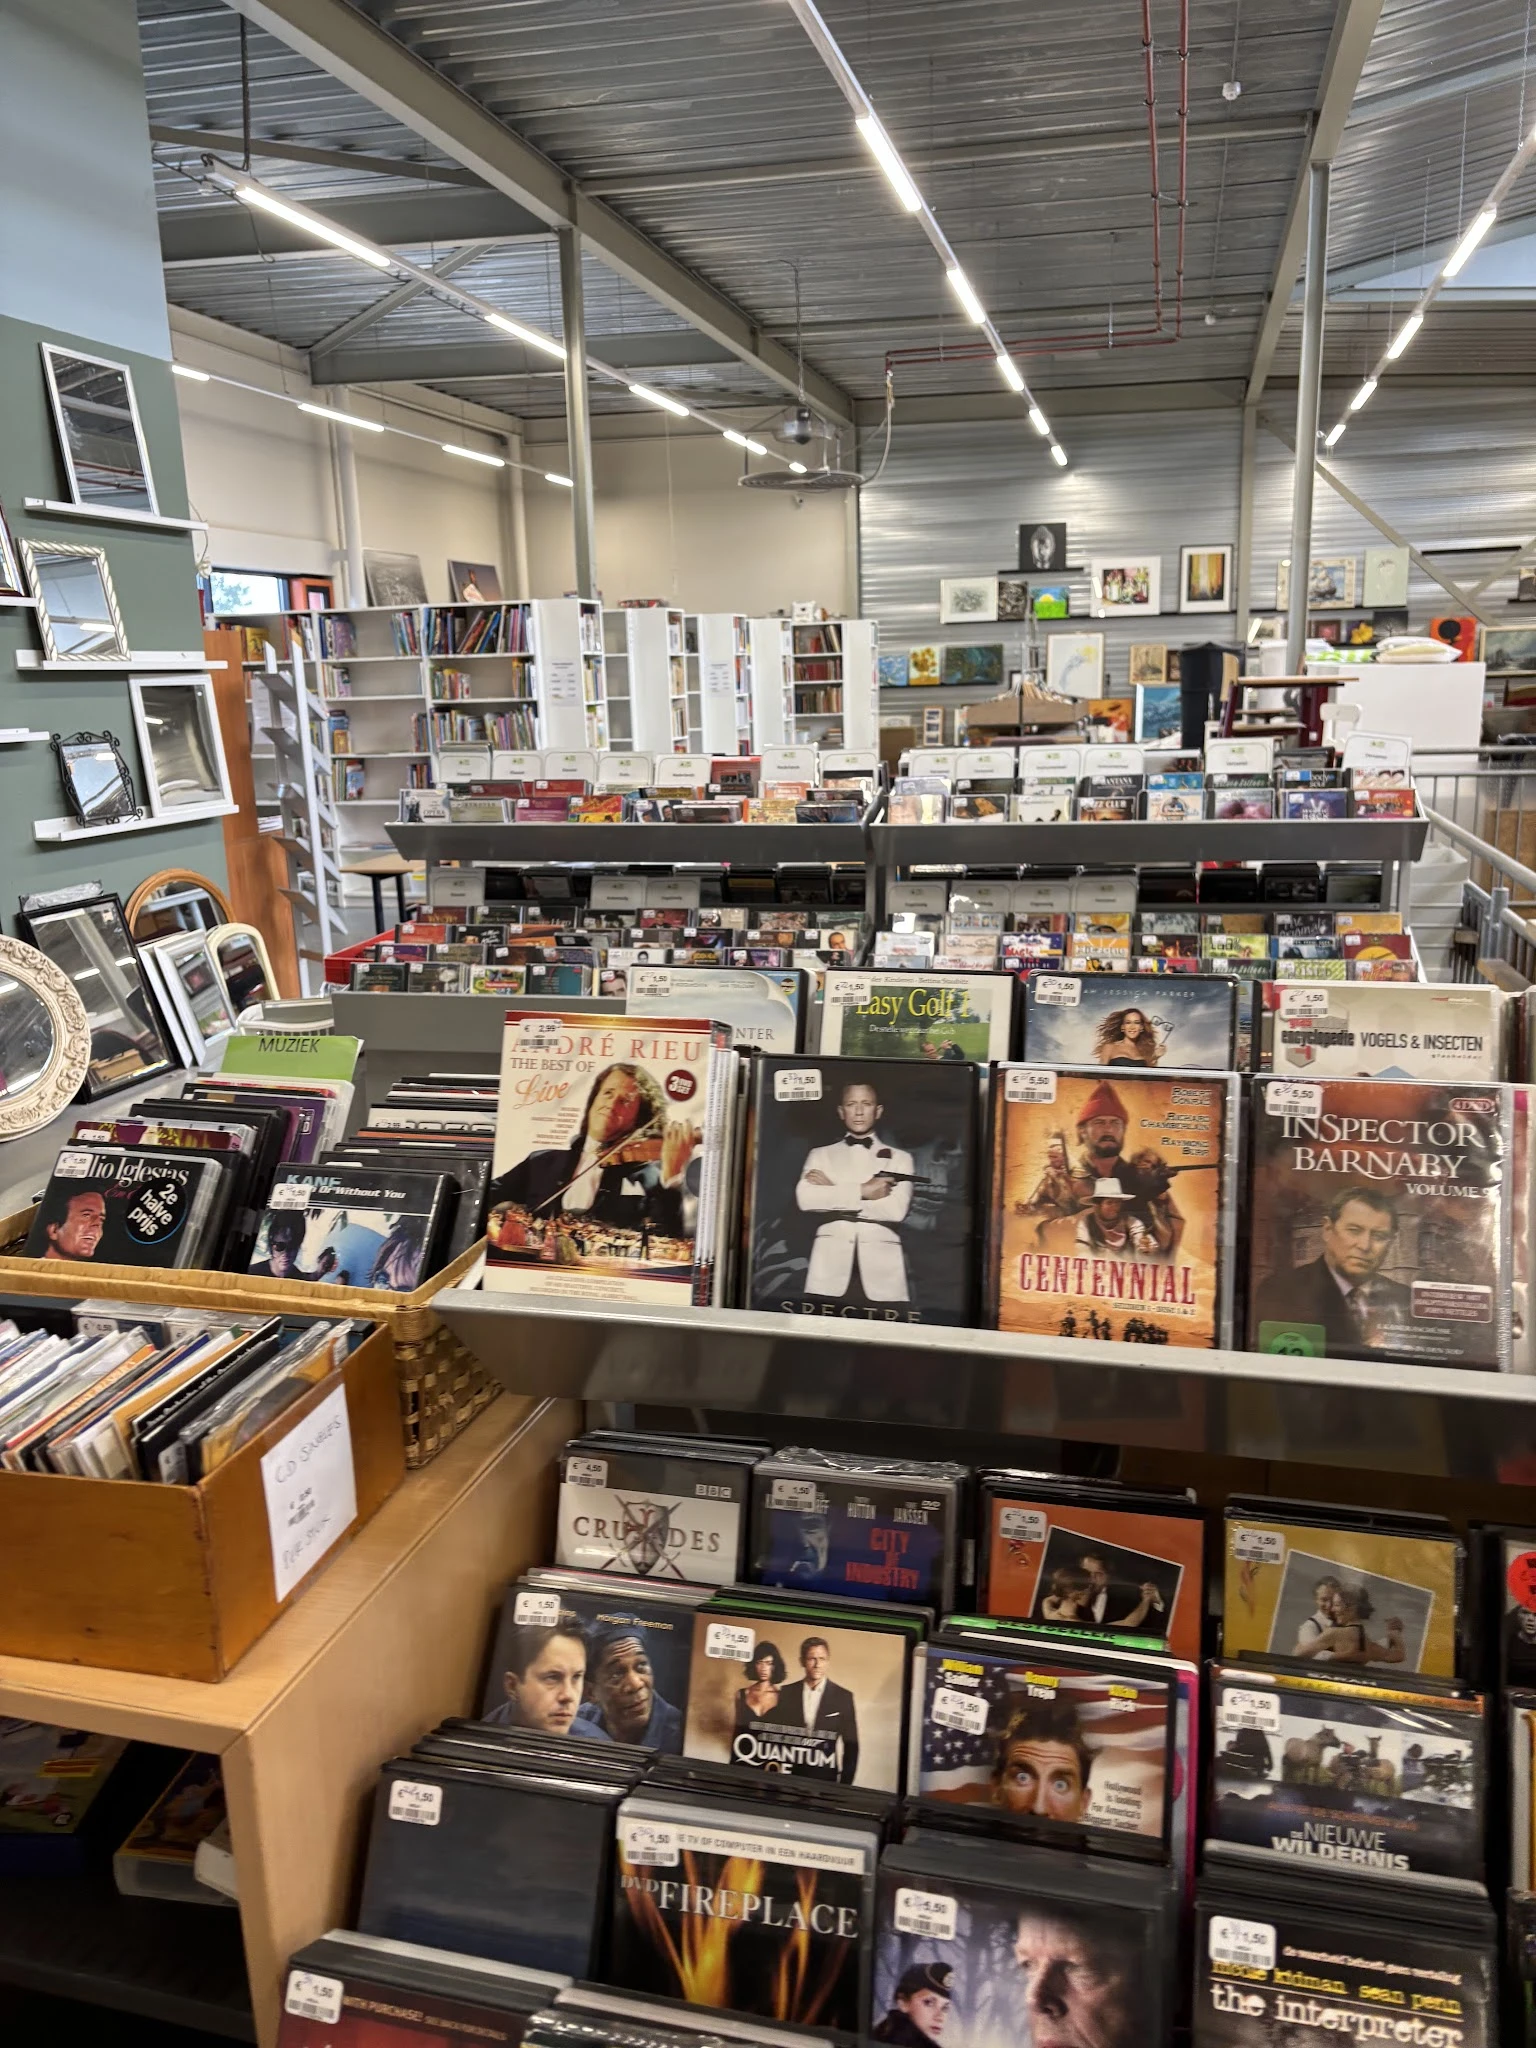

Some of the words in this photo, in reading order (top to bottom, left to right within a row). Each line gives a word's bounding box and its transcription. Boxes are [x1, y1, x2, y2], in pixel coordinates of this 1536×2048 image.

[908, 988, 956, 1018] Golf
[258, 1038, 321, 1053] MUZIEK
[630, 1036, 702, 1062] RIEU
[1361, 1032, 1408, 1049] VOGELS
[1411, 1035, 1421, 1049] &
[1423, 1035, 1484, 1052] INSECTEN
[510, 1057, 537, 1070] THE
[541, 1059, 571, 1072] BEST
[575, 1060, 596, 1073] OF
[513, 1073, 570, 1110] Live
[668, 1075, 679, 1093] 3
[1281, 1112, 1487, 1149] INSPECTOR
[1292, 1146, 1468, 1181] BARNABY
[158, 1183, 179, 1204] 2e
[331, 1186, 382, 1200] Without
[383, 1188, 408, 1201] You
[1406, 1182, 1481, 1198] VOLUME
[127, 1205, 159, 1236] prijs
[140, 1188, 174, 1227] halve
[1019, 1252, 1197, 1306] CENTENNIAL
[695, 1483, 733, 1499] BBC
[870, 1527, 912, 1554] CITY
[633, 1618, 675, 1632] Freeman
[733, 1733, 836, 1769] QUANTUM
[714, 1838, 765, 1852] COMPUTER
[1303, 1821, 1387, 1851] NIEUWE
[1270, 1836, 1411, 1872] WILDERNIS
[658, 1880, 860, 1940] FIREPLACE
[1273, 1967, 1348, 1995] kidman
[1359, 1983, 1405, 2006] sean
[1410, 1992, 1464, 2016] penn
[1210, 1983, 1267, 2018] the
[1274, 1994, 1465, 2048] interpreter
